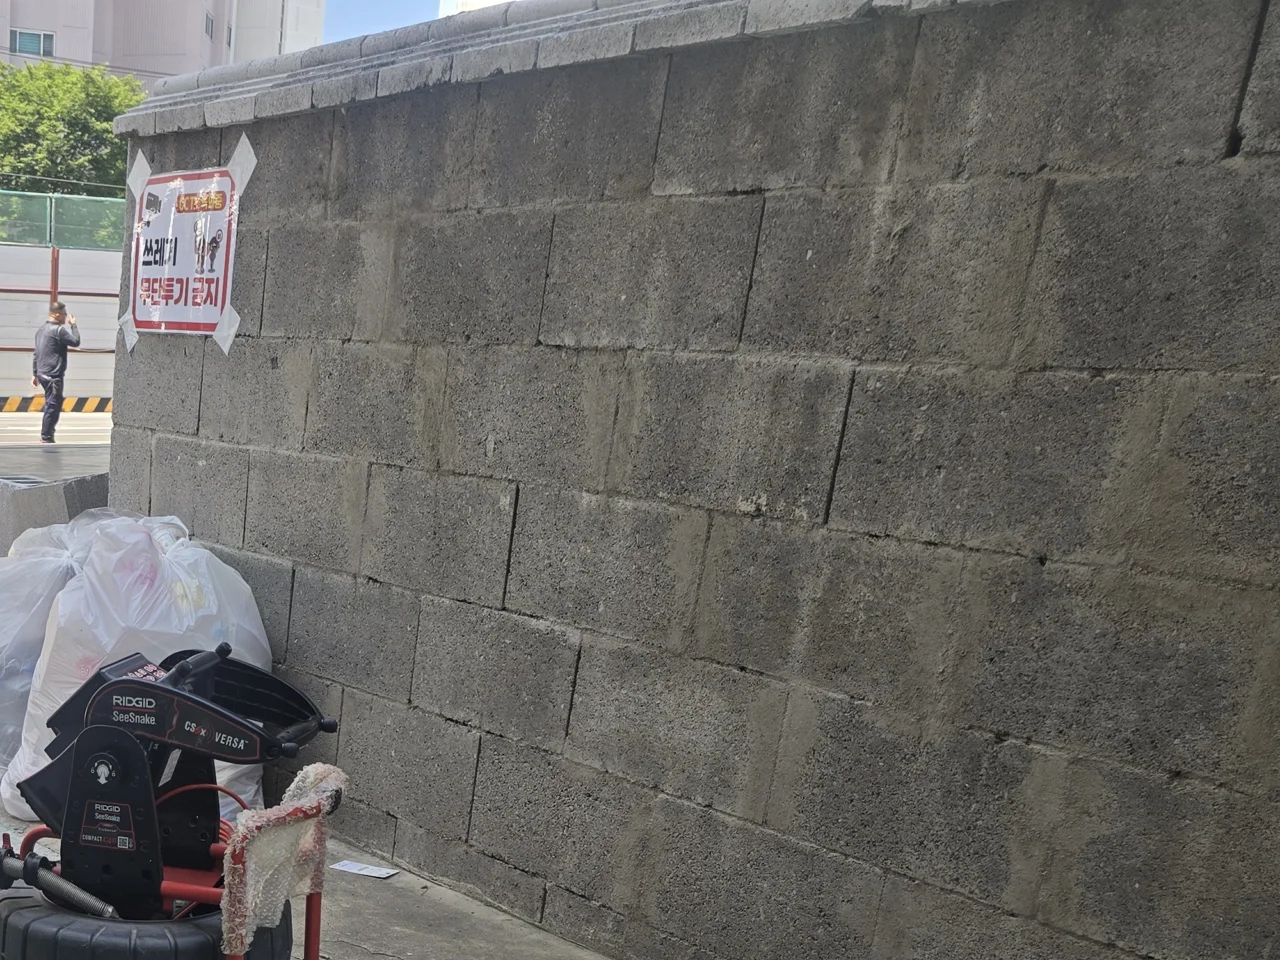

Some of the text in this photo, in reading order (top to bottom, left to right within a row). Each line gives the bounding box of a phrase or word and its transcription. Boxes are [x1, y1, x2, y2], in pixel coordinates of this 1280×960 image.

[142, 237, 177, 266] 쓰레기
[140, 277, 219, 308] 무단투기 금지
[113, 695, 156, 708] RIDGID
[113, 710, 156, 725] SeeSnake
[94, 803, 121, 813] RIDGID
